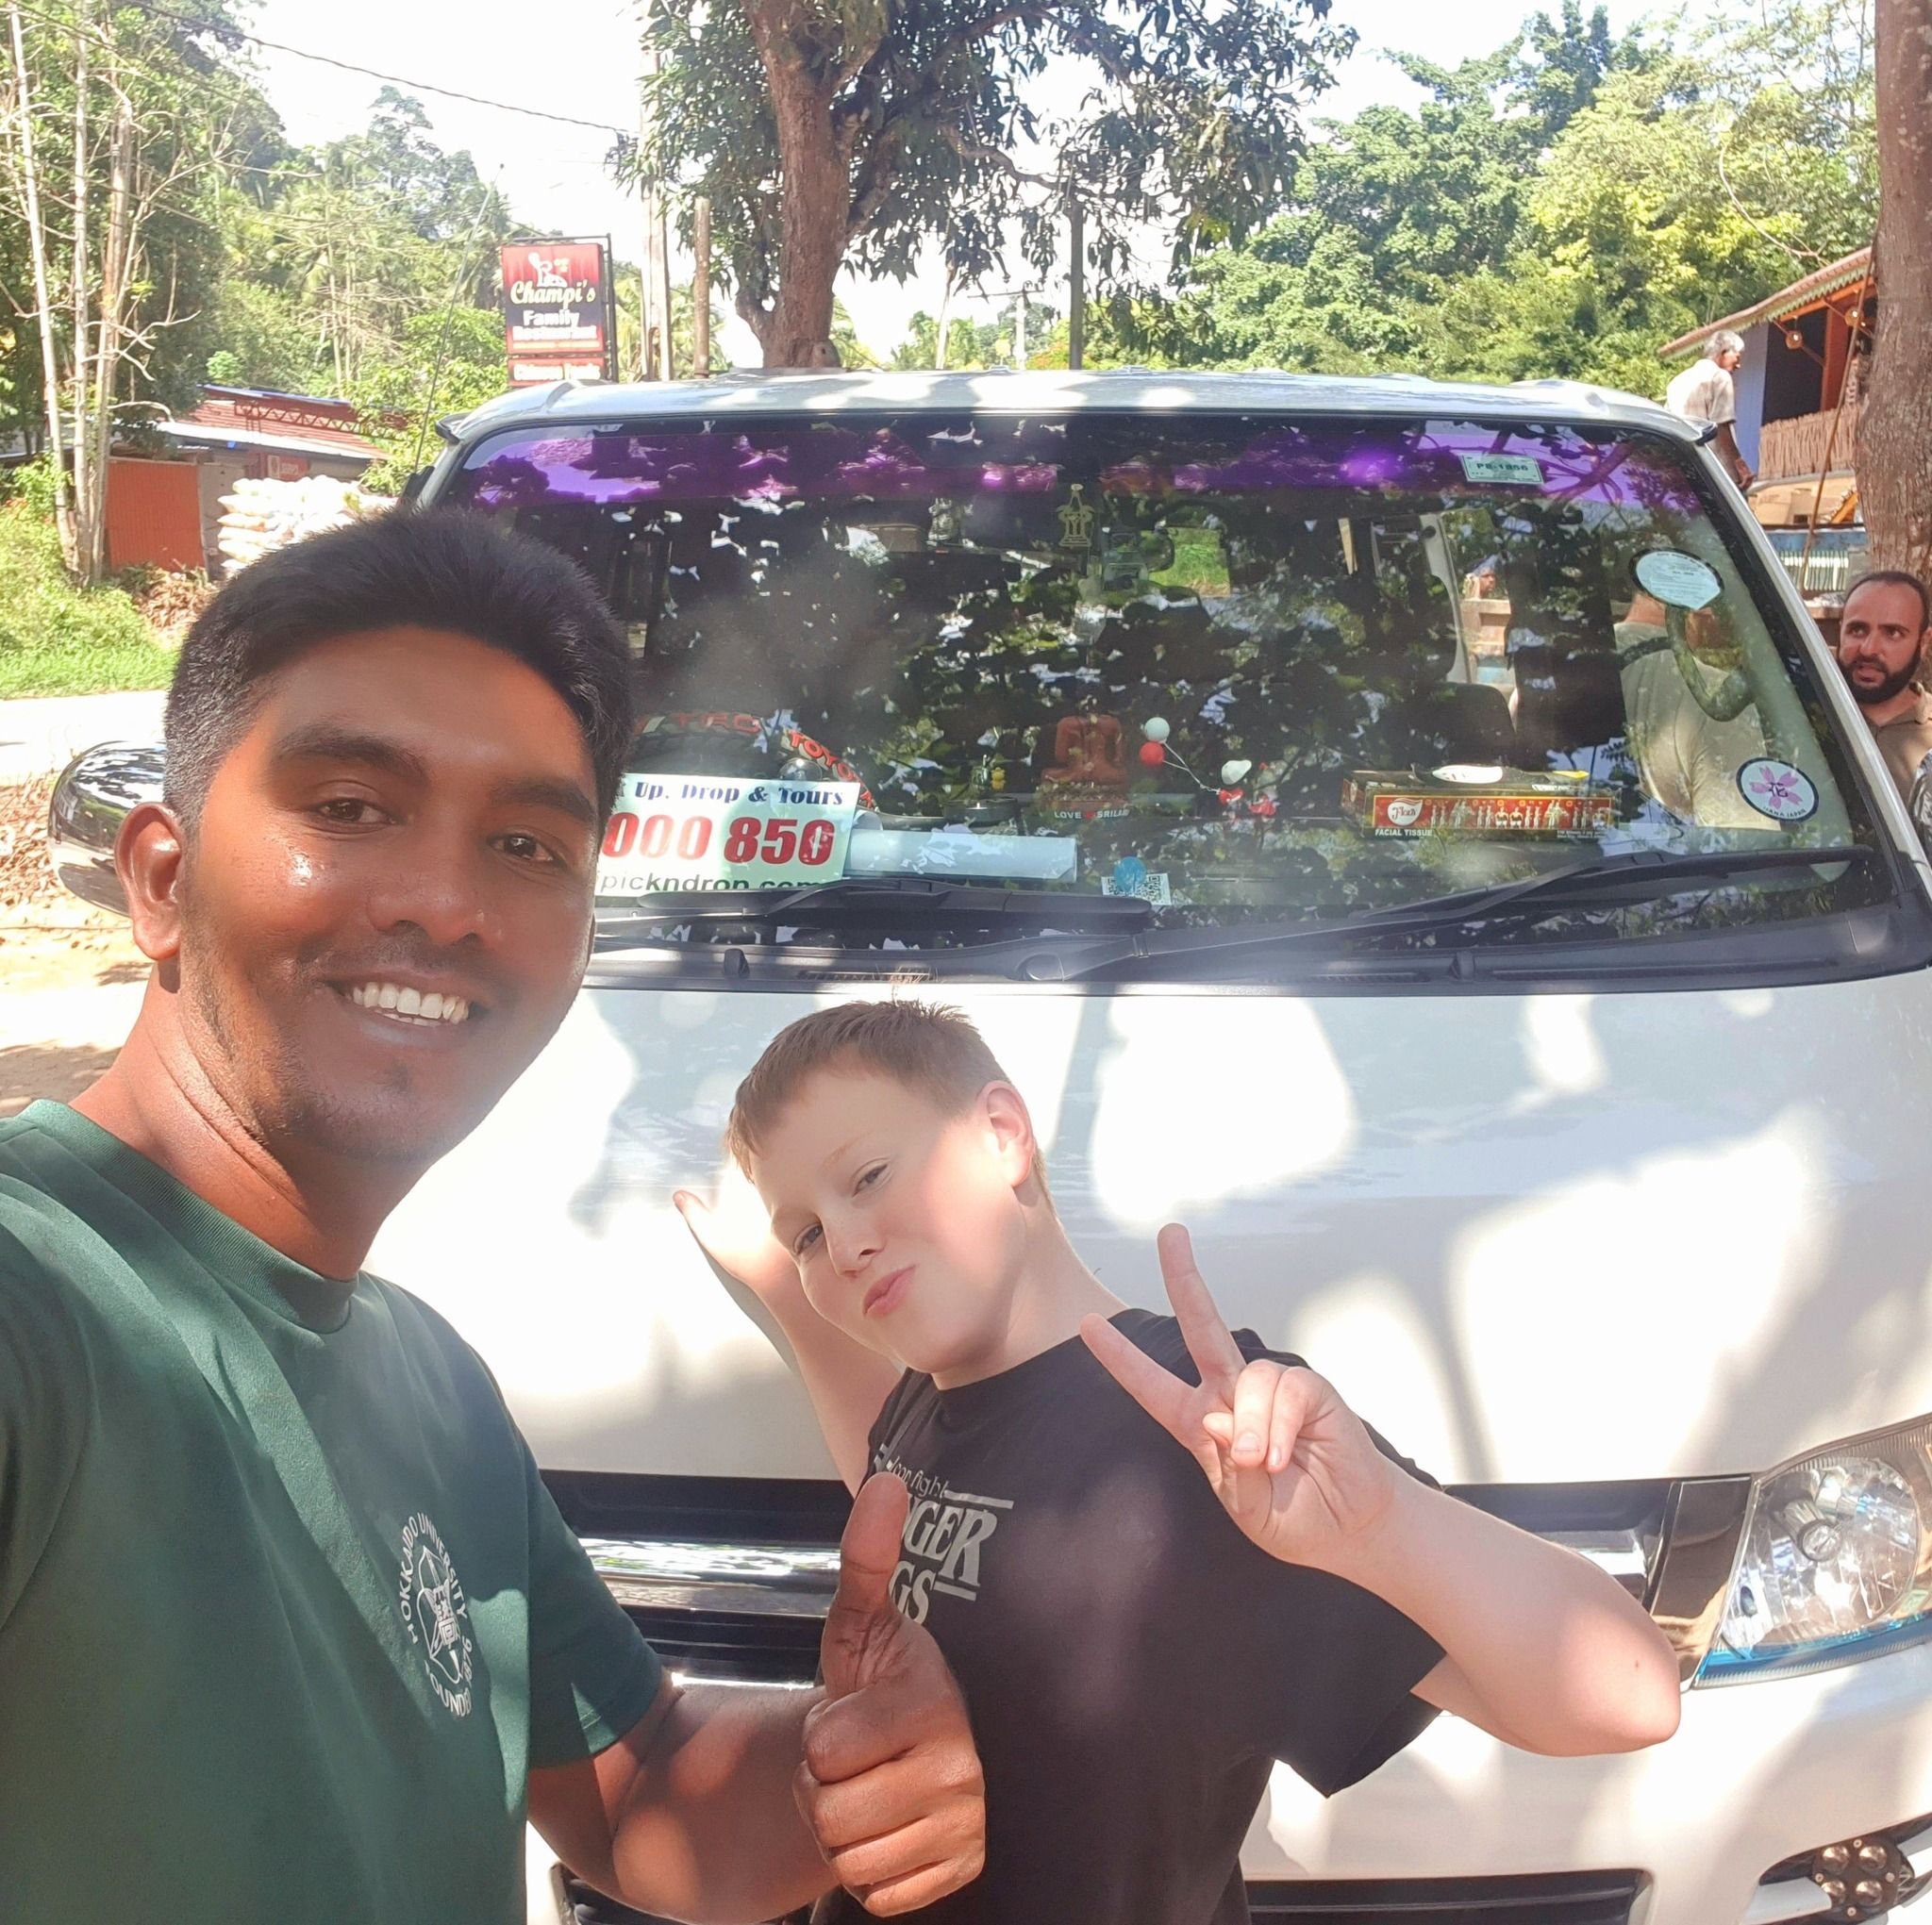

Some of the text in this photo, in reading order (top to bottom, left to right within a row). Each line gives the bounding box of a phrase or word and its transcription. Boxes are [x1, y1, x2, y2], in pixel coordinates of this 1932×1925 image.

[510, 279, 596, 310] Champi's
[523, 308, 580, 328] Family
[789, 730, 874, 809] TOYOA
[681, 784, 740, 803] Drop
[748, 786, 769, 803] &
[778, 787, 842, 805] Tours
[1054, 811, 1082, 820] LOVE
[601, 812, 836, 866] 000 850
[1374, 828, 1433, 837] FACIAL TISSUE
[909, 1469, 949, 1499] fight
[400, 1516, 419, 1644] HOKKAIDO
[417, 1512, 468, 1619] UNIVERSITY
